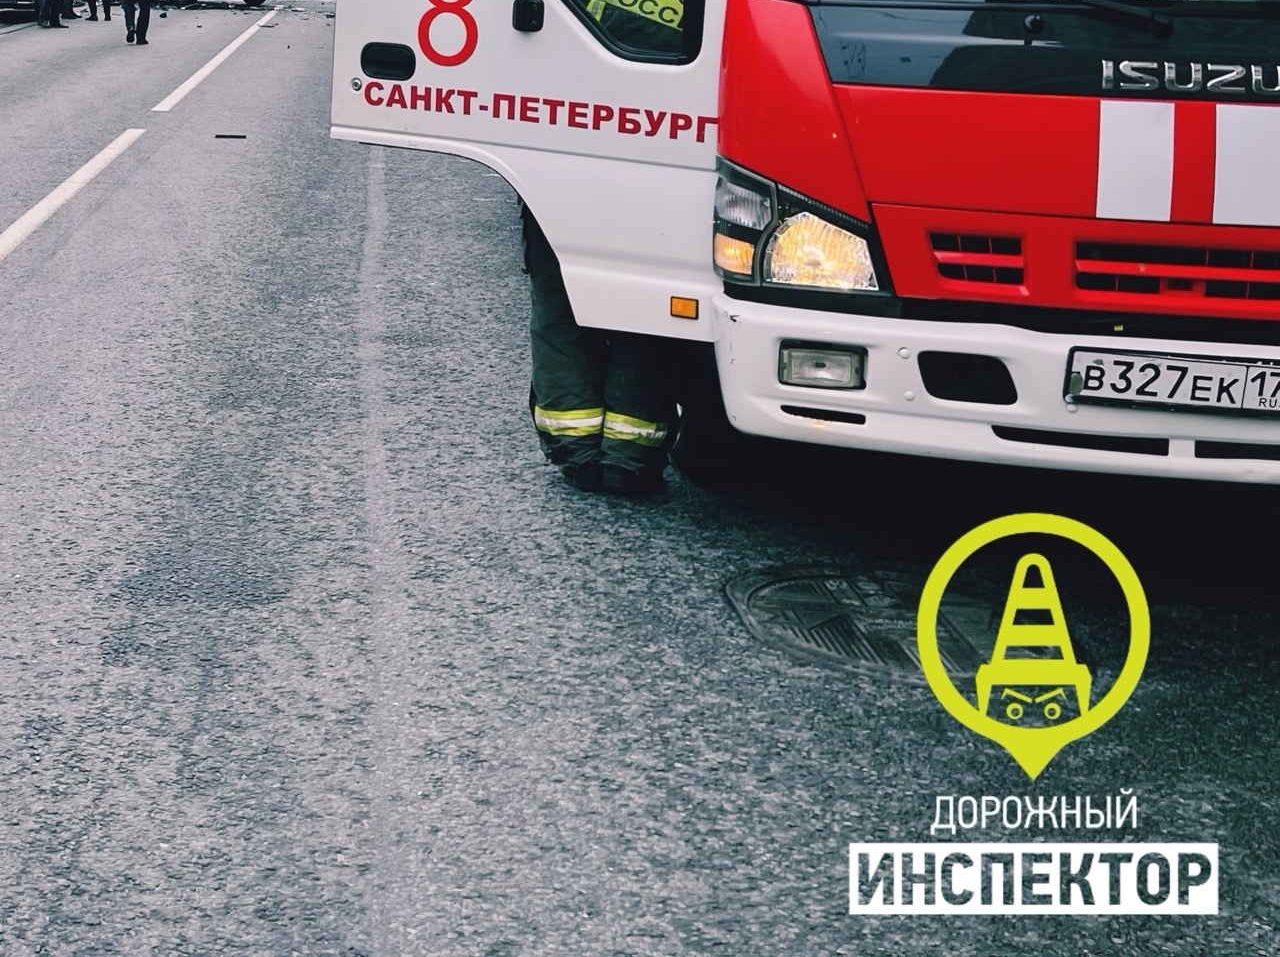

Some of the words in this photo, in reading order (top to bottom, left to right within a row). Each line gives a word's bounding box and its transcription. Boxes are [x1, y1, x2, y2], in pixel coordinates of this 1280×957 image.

[1101, 59, 1280, 93] ISUZU
[363, 80, 720, 143] САНКТ-ПЕТЕРБУРГ
[1083, 360, 1240, 405] В327ЕК
[1258, 397, 1280, 409] RU
